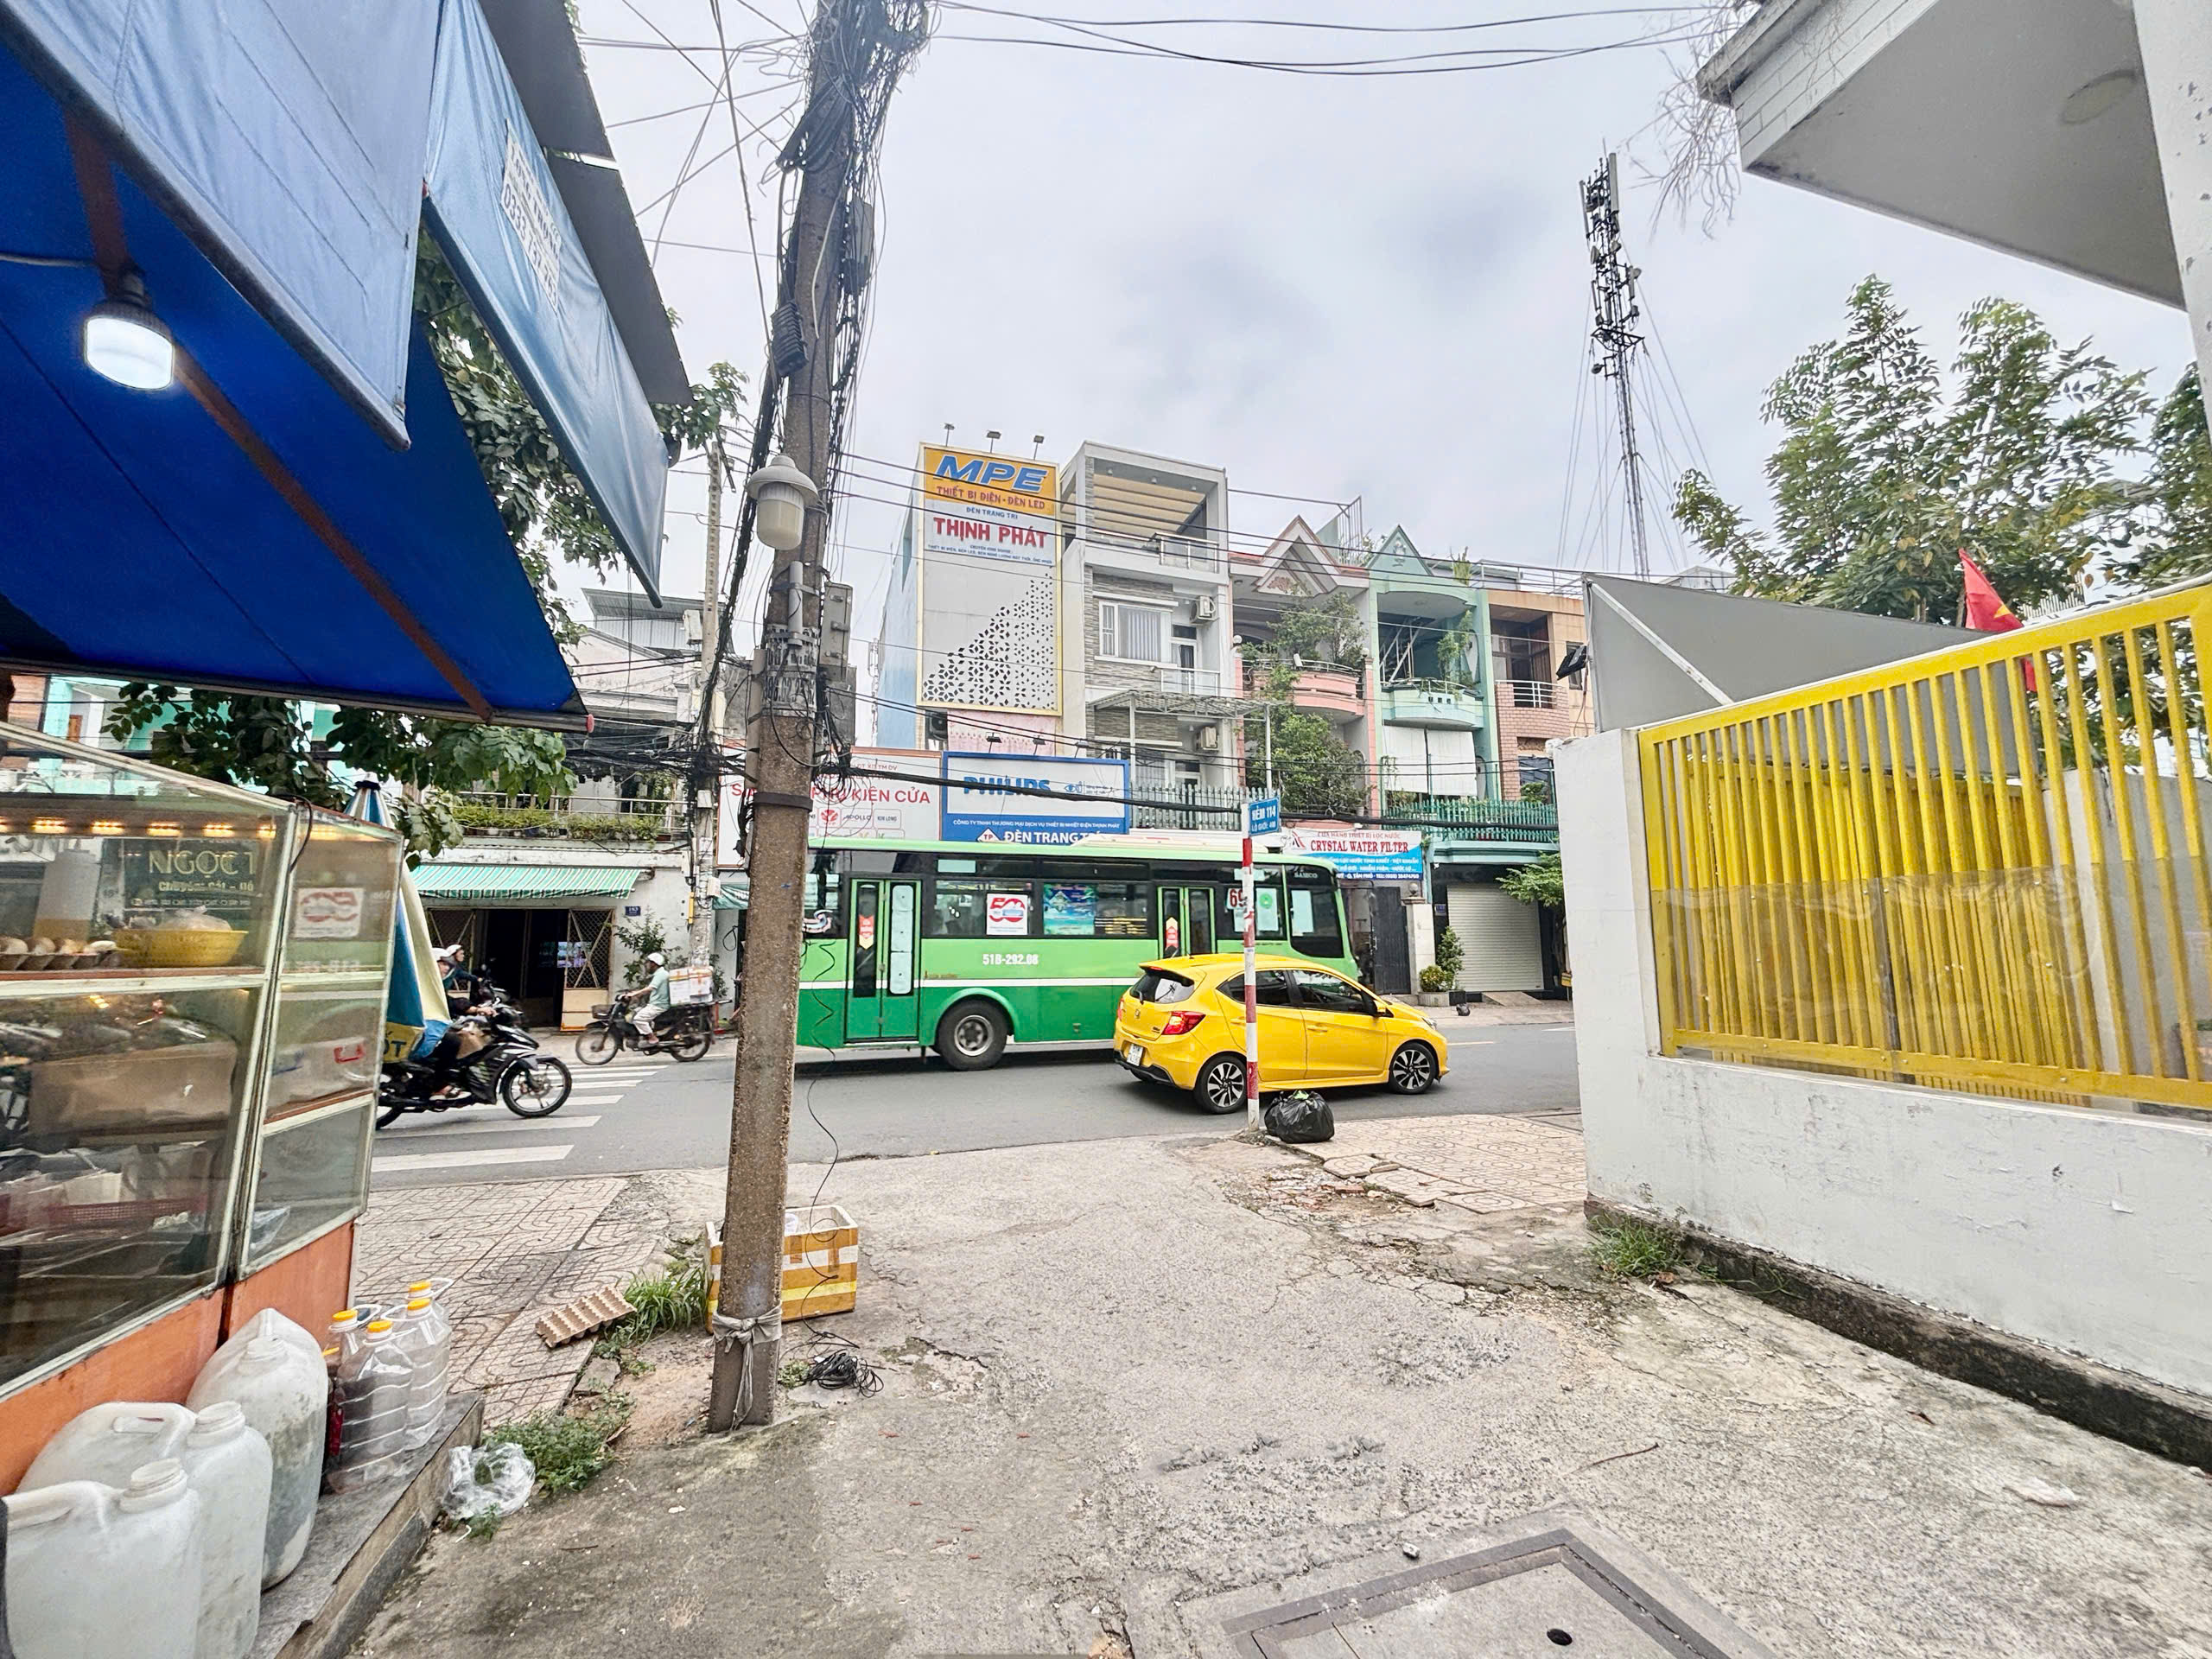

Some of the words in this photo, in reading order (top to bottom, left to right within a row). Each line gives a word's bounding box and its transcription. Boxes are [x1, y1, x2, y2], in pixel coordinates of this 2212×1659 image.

[935, 454, 1048, 493] MPE
[937, 485, 964, 498] THIẾT
[967, 490, 977, 501] BỊ
[1007, 495, 1026, 507] ĐÈN
[1028, 499, 1045, 510] LED
[982, 508, 1005, 518] TRANG
[933, 517, 990, 542] THỊNH
[998, 525, 1047, 549] PHÁT
[894, 786, 931, 804] CỬA
[1266, 804, 1276, 818] 114
[1003, 829, 1032, 843] ĐÈN
[1033, 831, 1079, 844] TRANG
[1310, 840, 1348, 852] CRYSTAL
[1350, 841, 1379, 852] WATER
[1380, 841, 1409, 854] FILTER
[149, 849, 239, 879] NGỌC
[982, 953, 1039, 965] 51B-292.08
